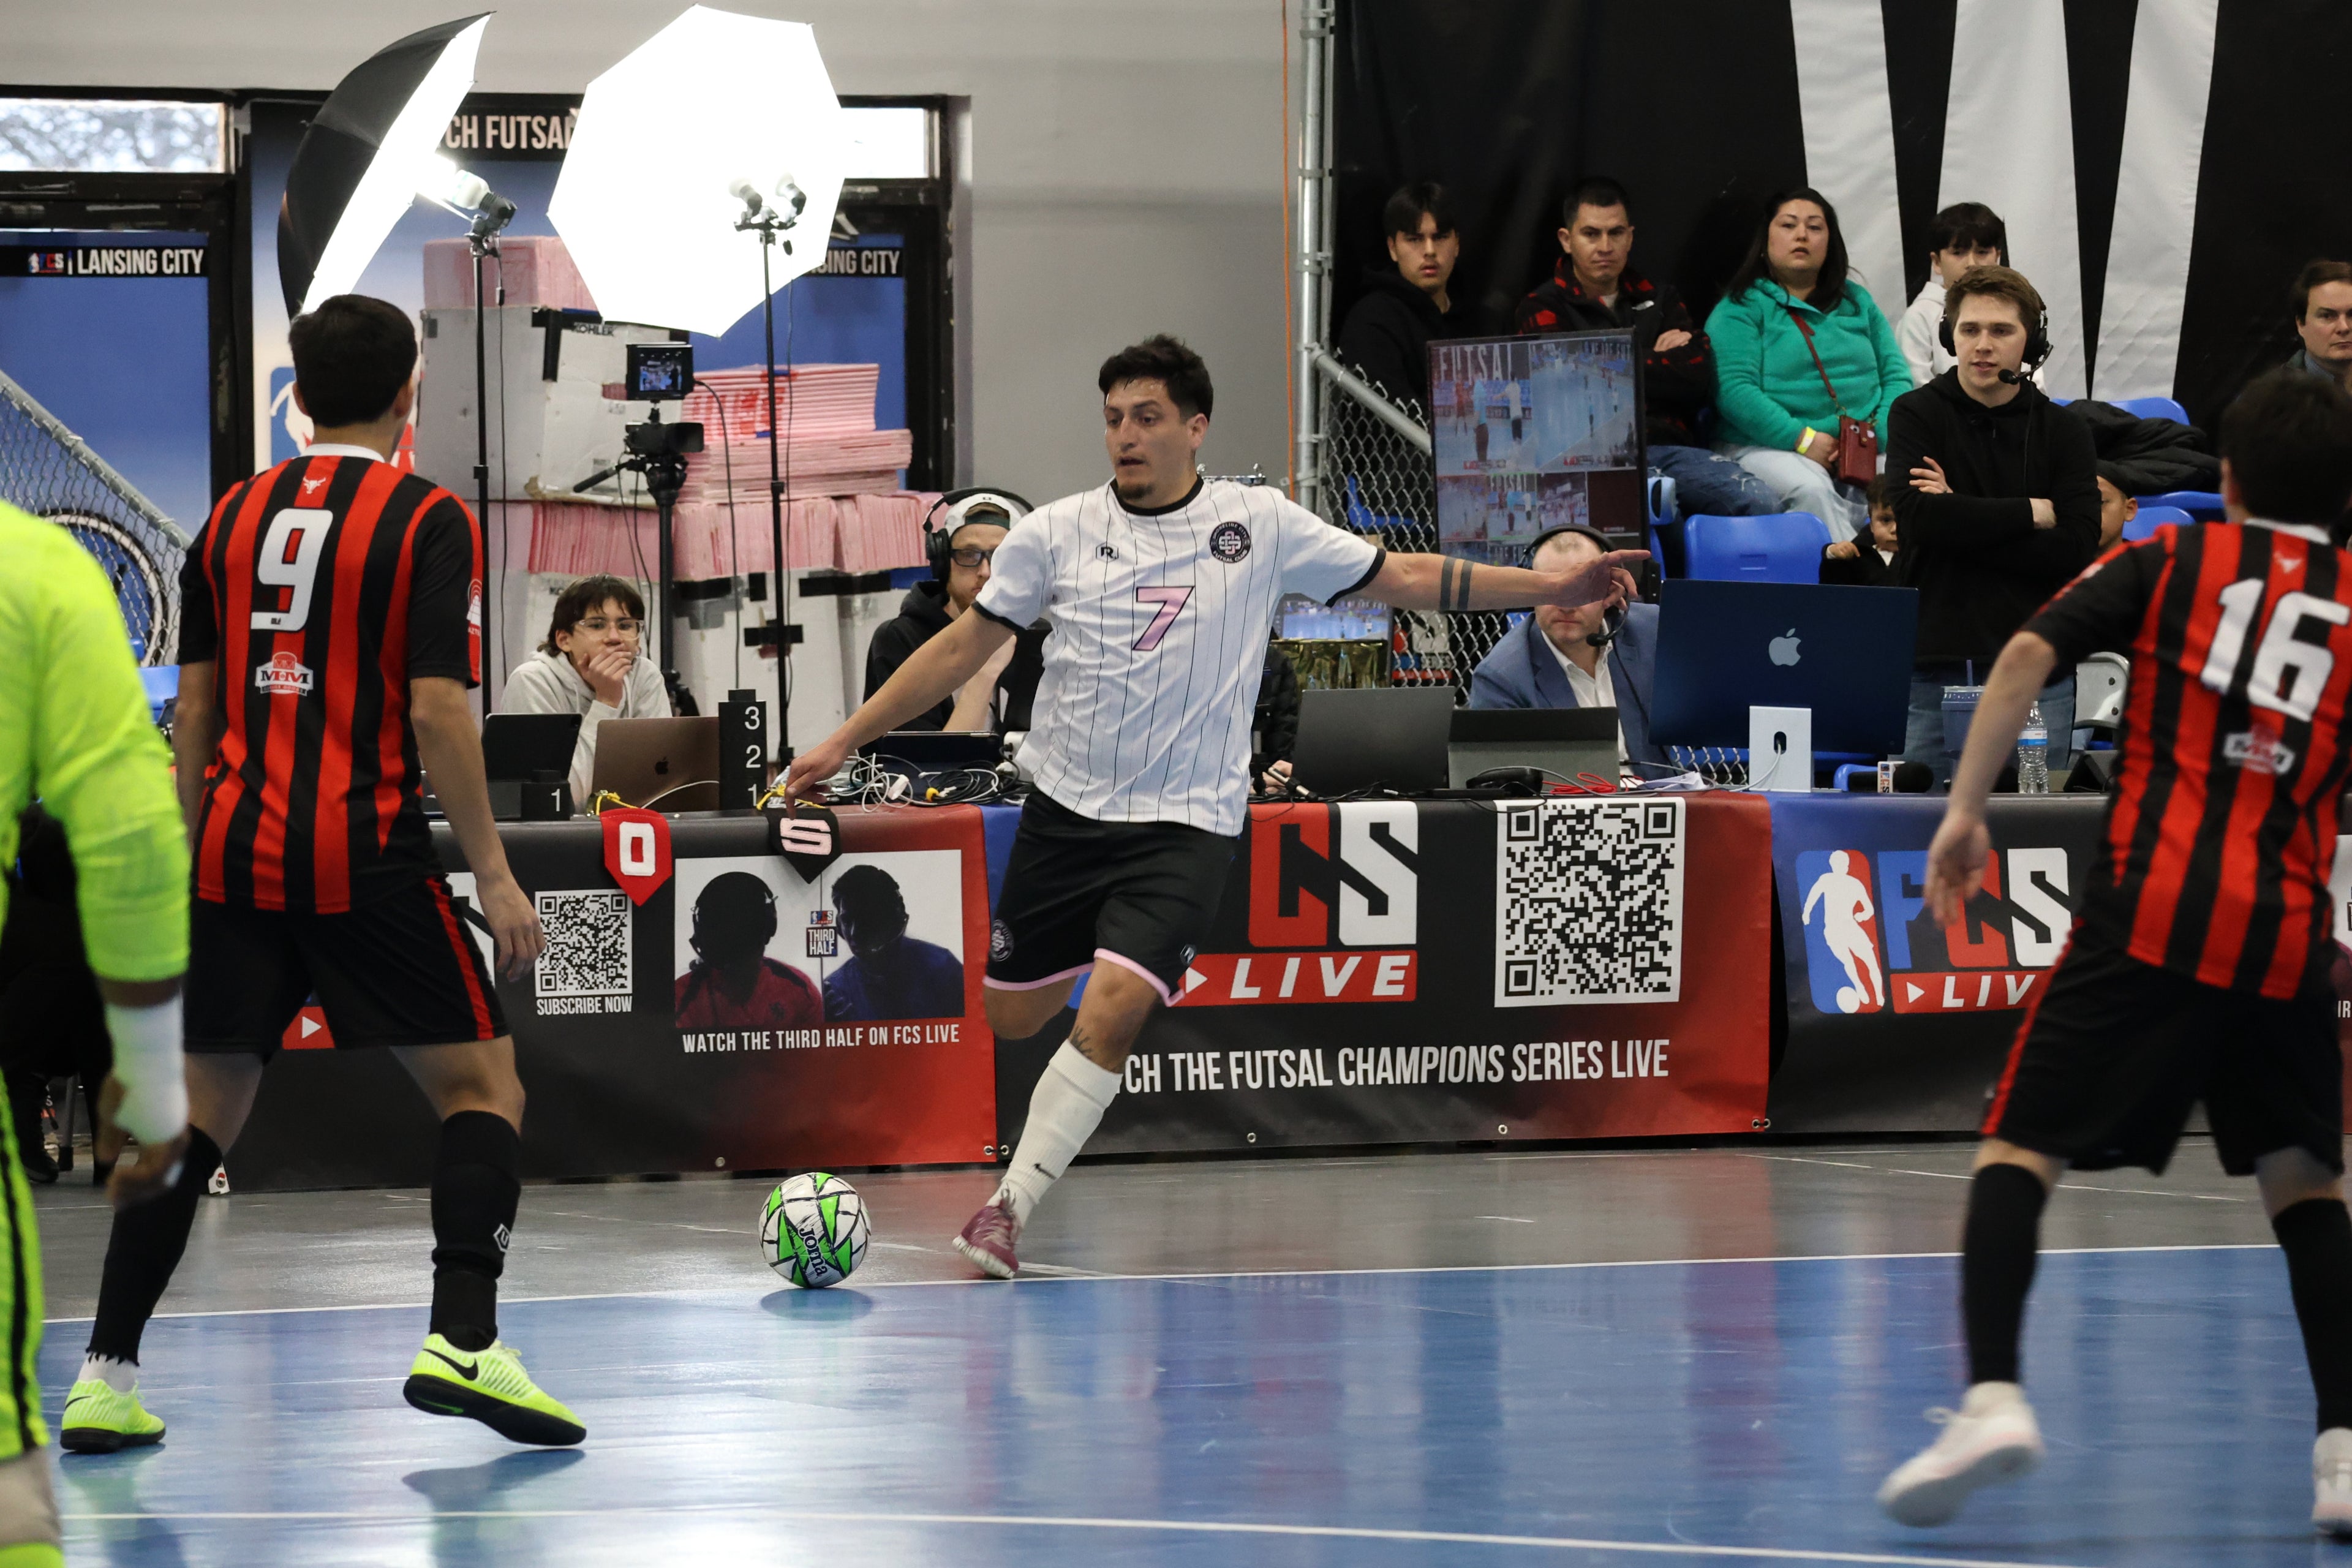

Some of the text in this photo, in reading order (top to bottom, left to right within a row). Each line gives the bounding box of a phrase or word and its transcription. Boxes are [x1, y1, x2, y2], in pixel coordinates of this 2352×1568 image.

[445, 115, 478, 148] CH
[77, 249, 203, 274] LANSING CITY
[861, 250, 900, 274] CITY
[251, 508, 333, 631] 9
[1132, 586, 1195, 651] 7
[2201, 577, 2351, 722] 16
[745, 706, 760, 729] 3
[746, 745, 761, 768] 2
[551, 788, 560, 812] 1
[748, 783, 757, 806] 1
[1248, 801, 1419, 948] CS
[1878, 847, 2073, 969] FCS
[808, 929, 835, 941] THIRD
[809, 941, 835, 956] HALF
[1230, 955, 1410, 998] LIVE
[1942, 974, 2036, 1008] LIV
[536, 995, 633, 1016] SUBSCRIBE NOW
[682, 1023, 960, 1053] WATCH THE THIRD HALF ON FCS LIVE
[1118, 1039, 1670, 1093] CH THE FUTSAL CHAMPIONS SERIES LIVE
